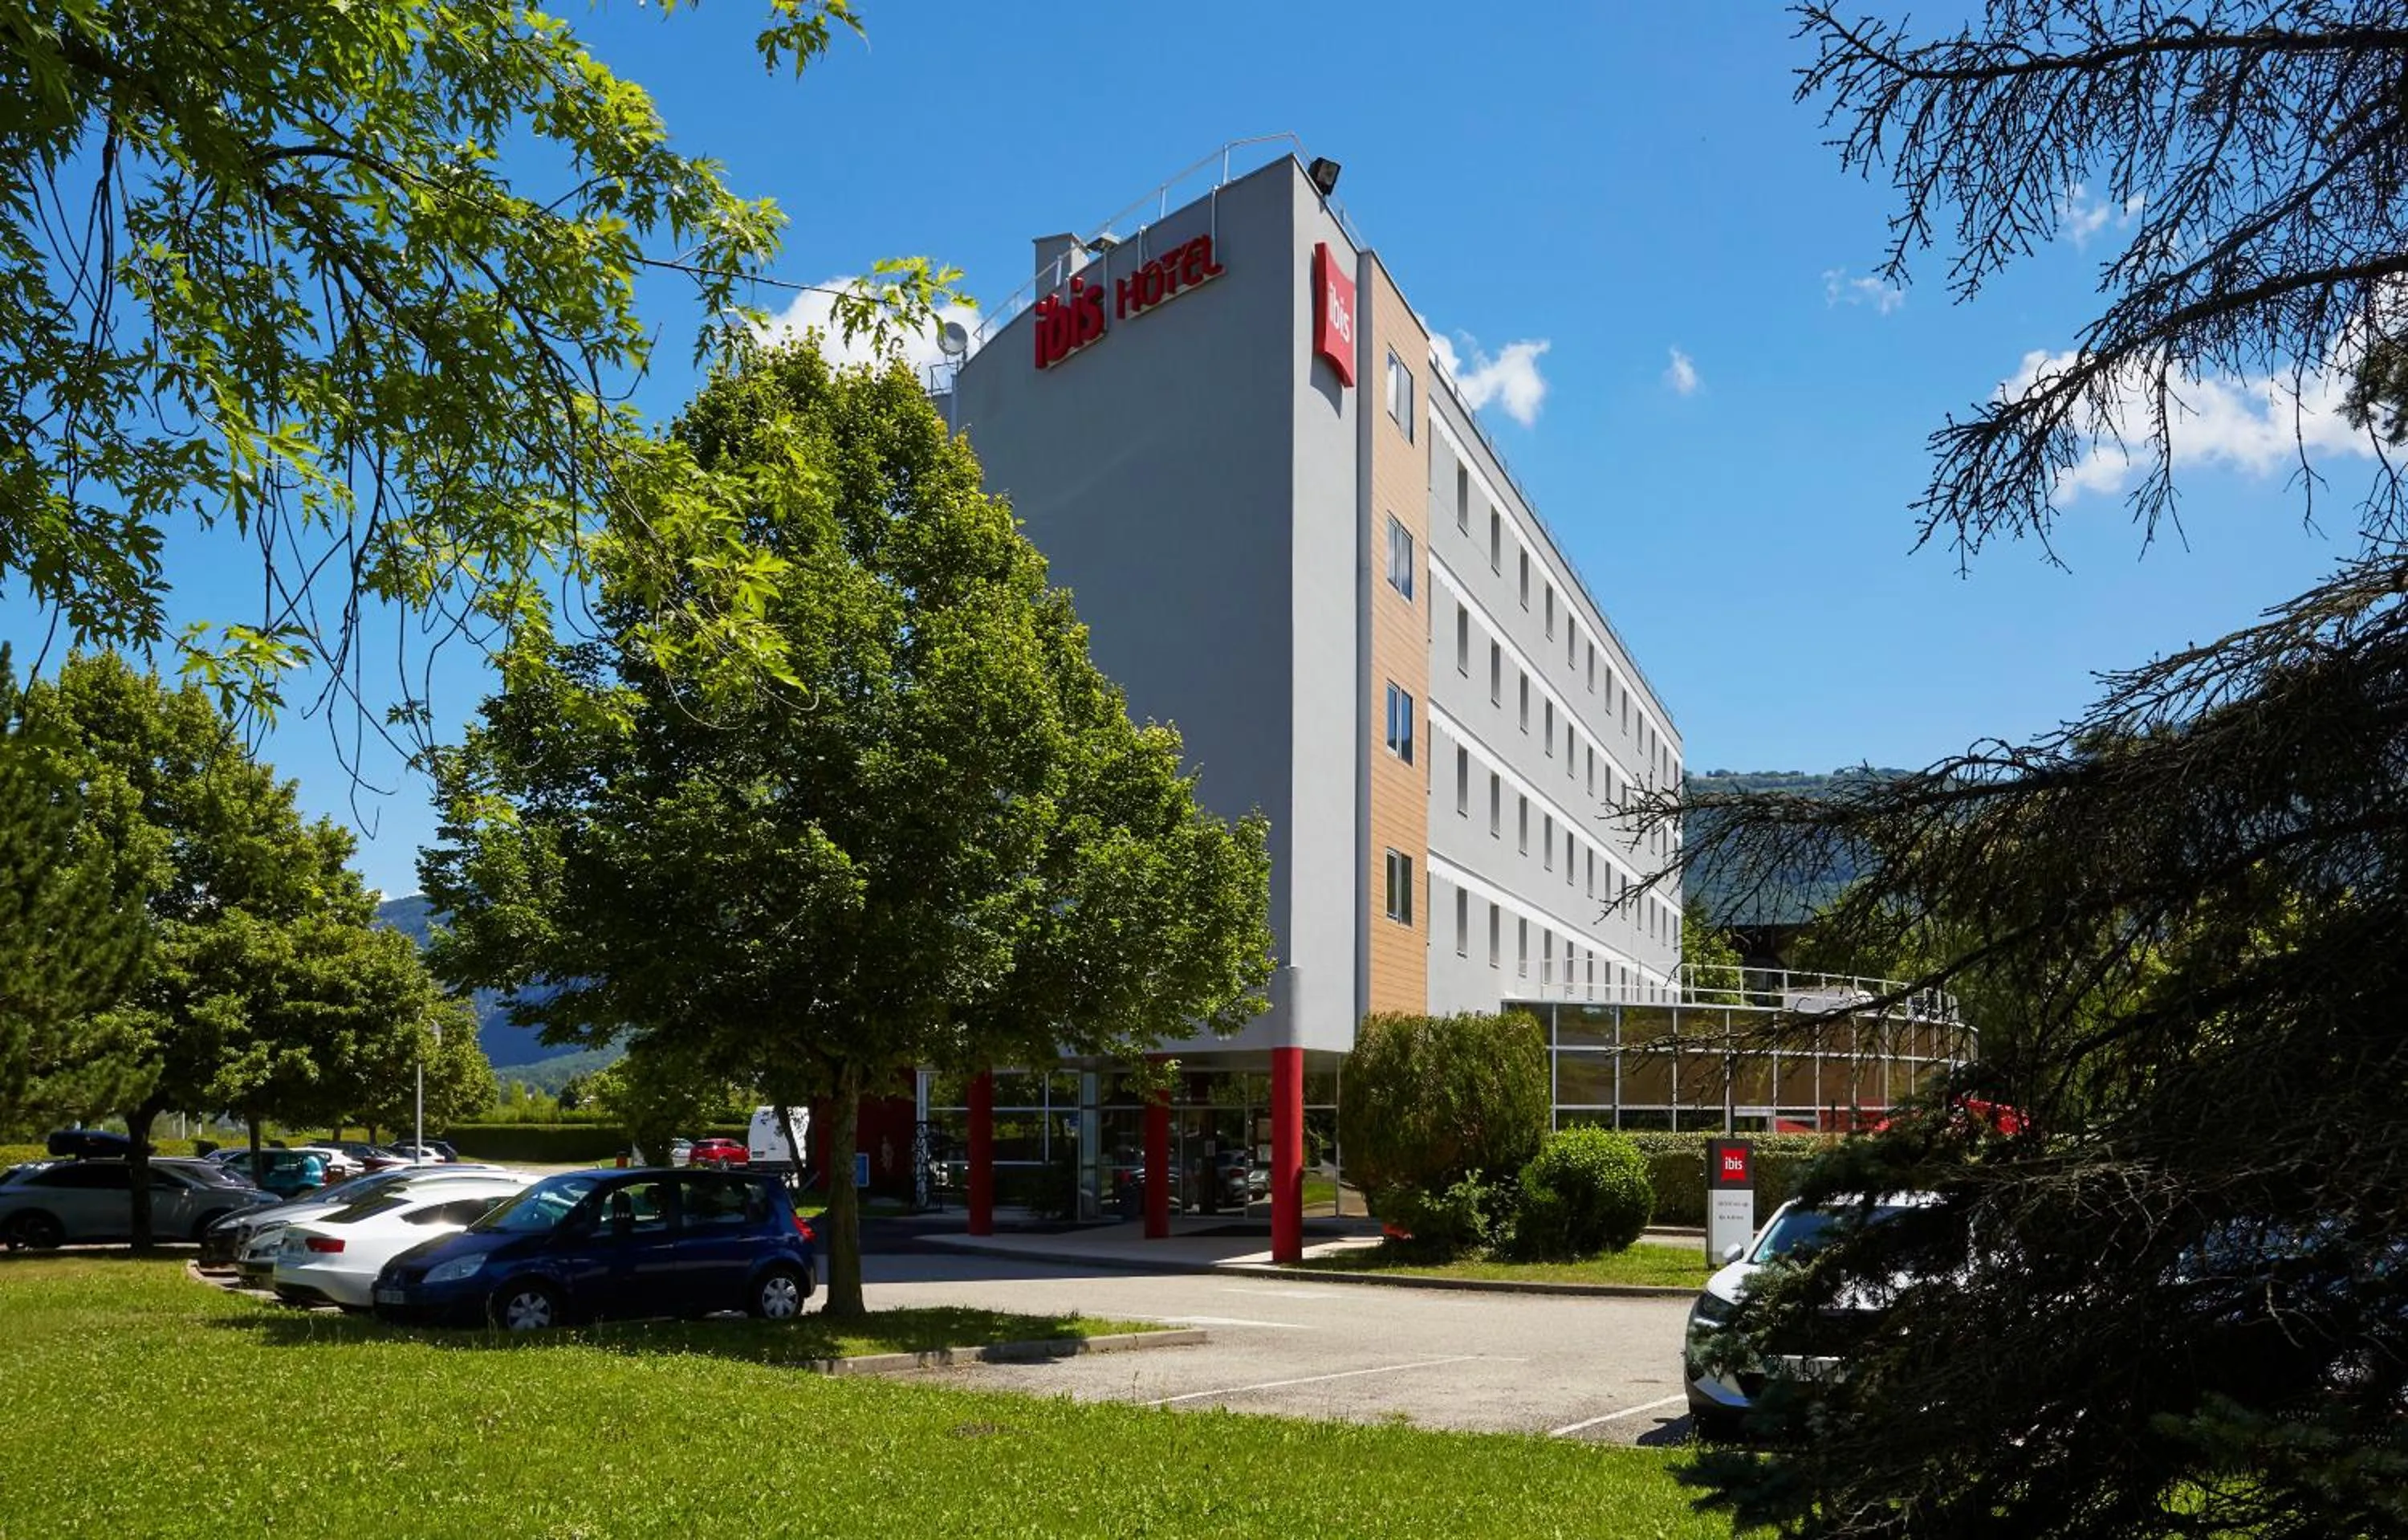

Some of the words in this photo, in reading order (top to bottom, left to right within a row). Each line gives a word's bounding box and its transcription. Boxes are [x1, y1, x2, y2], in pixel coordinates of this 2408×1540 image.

[1035, 277, 1104, 369] ibis
[1329, 282, 1350, 343] ibis
[1725, 1157, 1743, 1170] ibis
